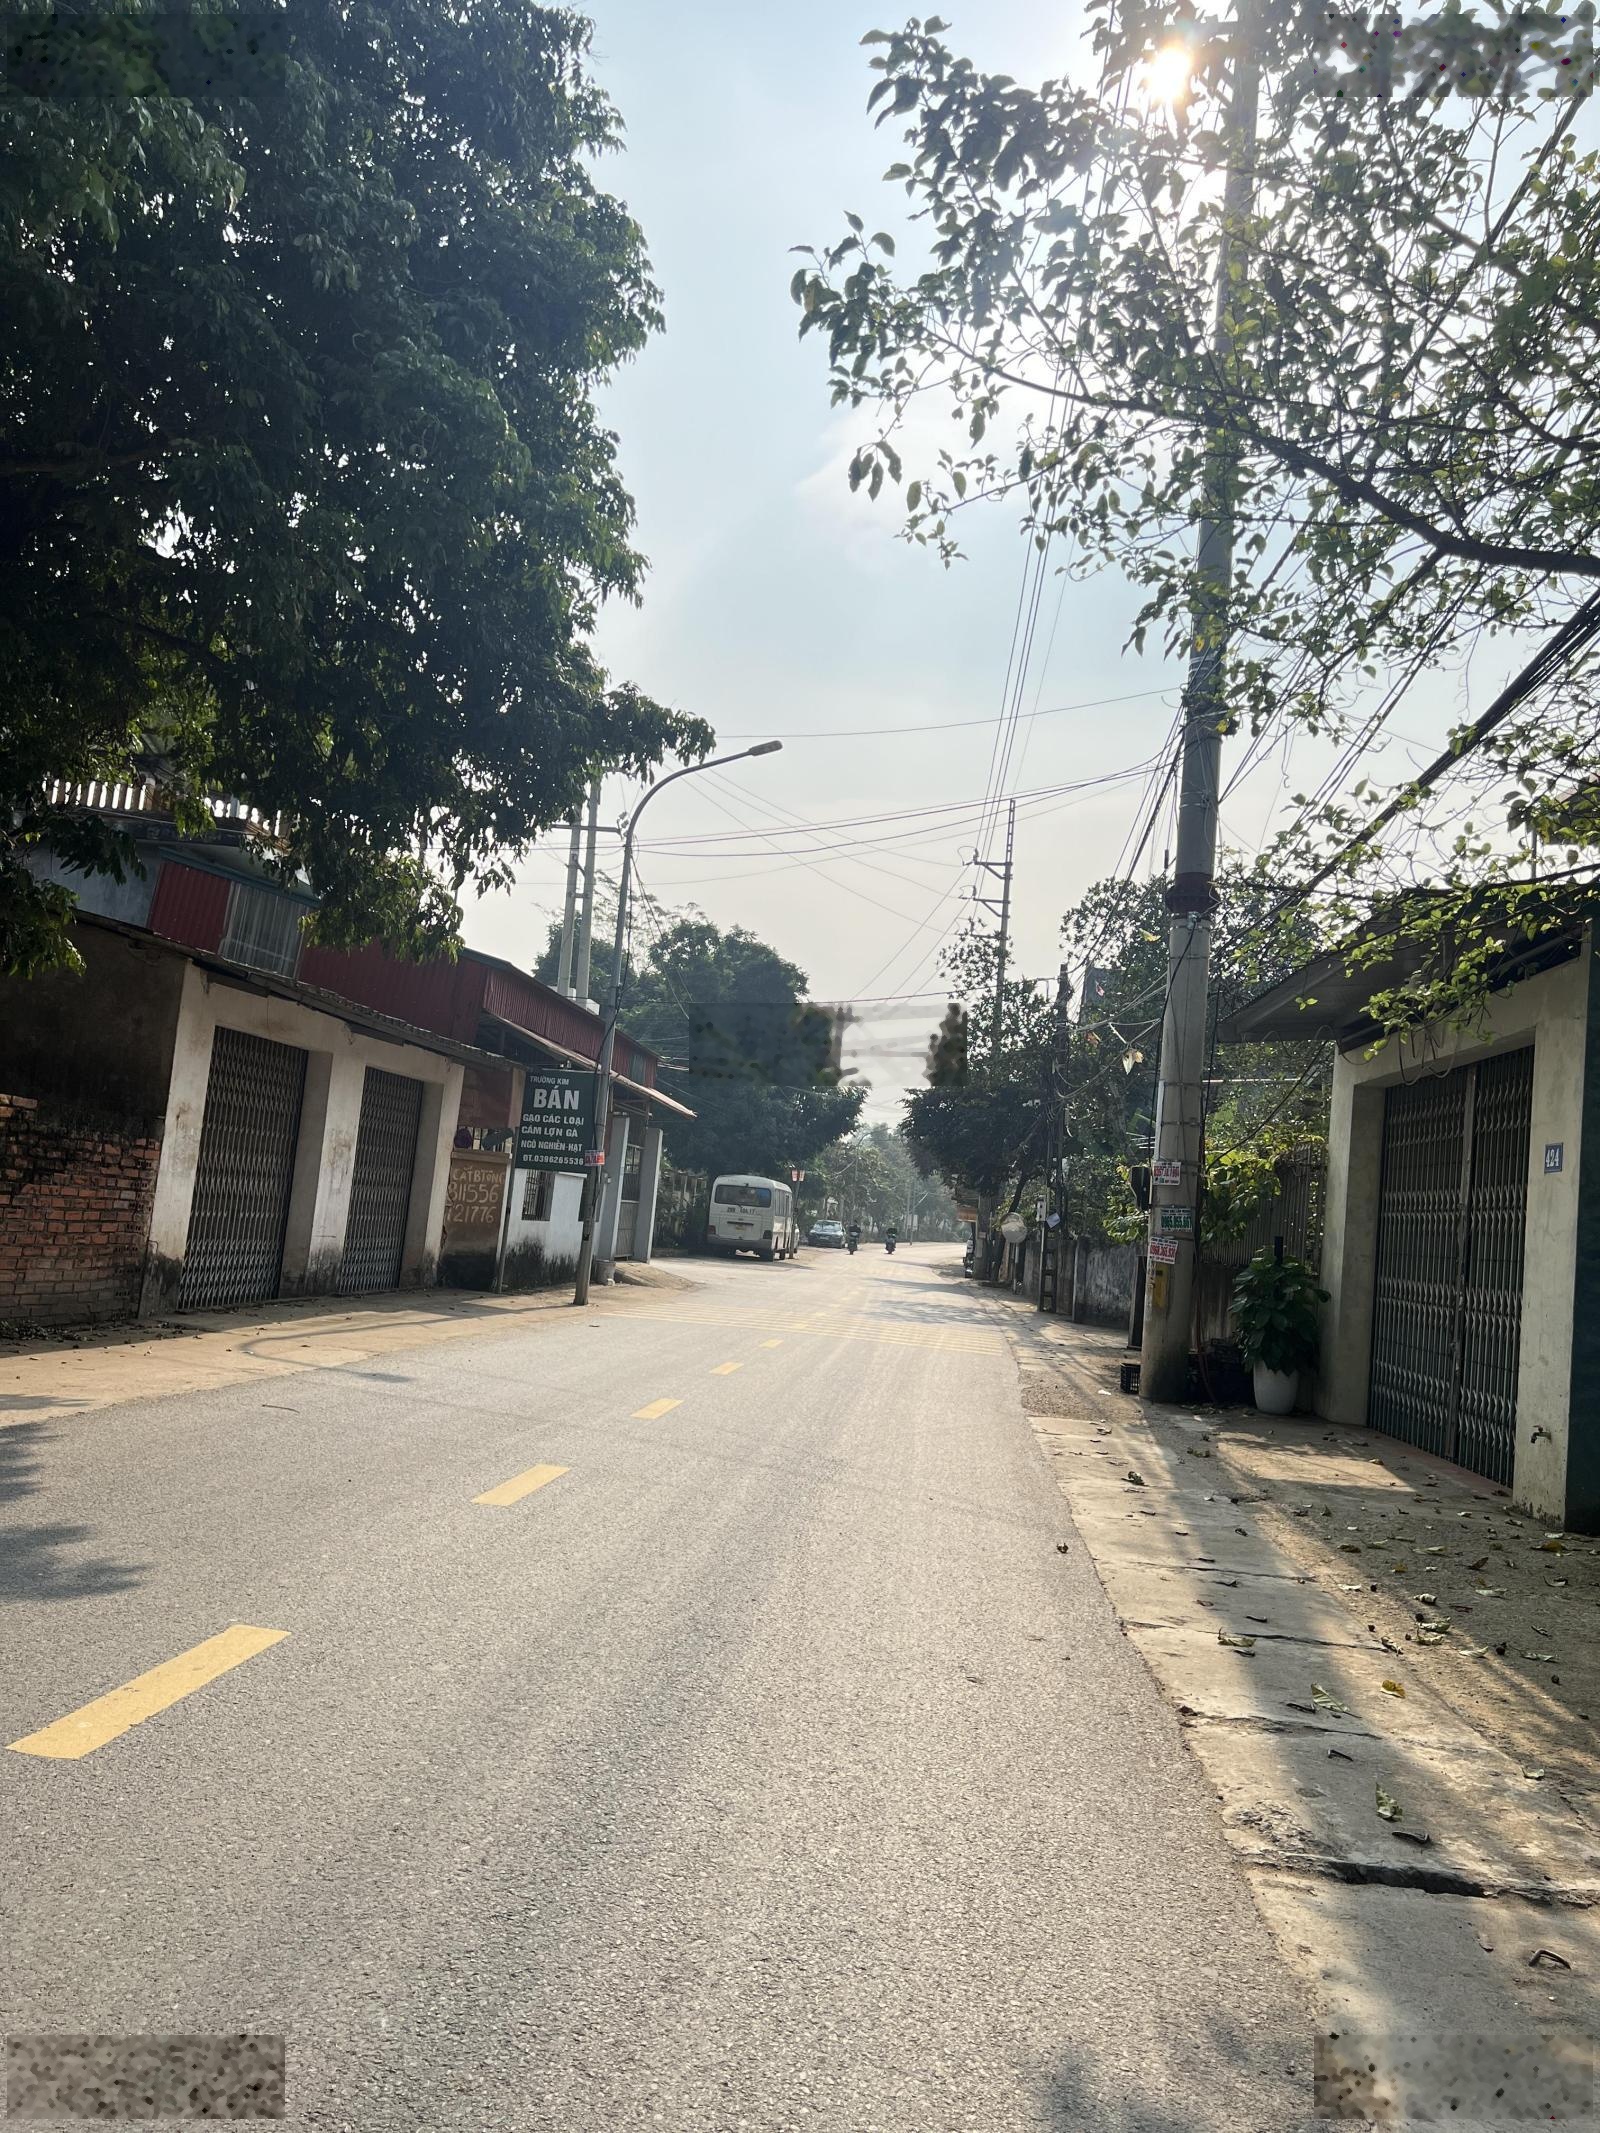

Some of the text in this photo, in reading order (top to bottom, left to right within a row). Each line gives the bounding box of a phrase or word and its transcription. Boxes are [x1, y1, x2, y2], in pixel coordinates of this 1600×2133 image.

[533, 1085, 579, 1110] BÁN
[543, 1114, 561, 1124] CÁC
[564, 1116, 584, 1127] LOẠI
[544, 1126, 563, 1137] LỢN
[1546, 1148, 1560, 1167] 424
